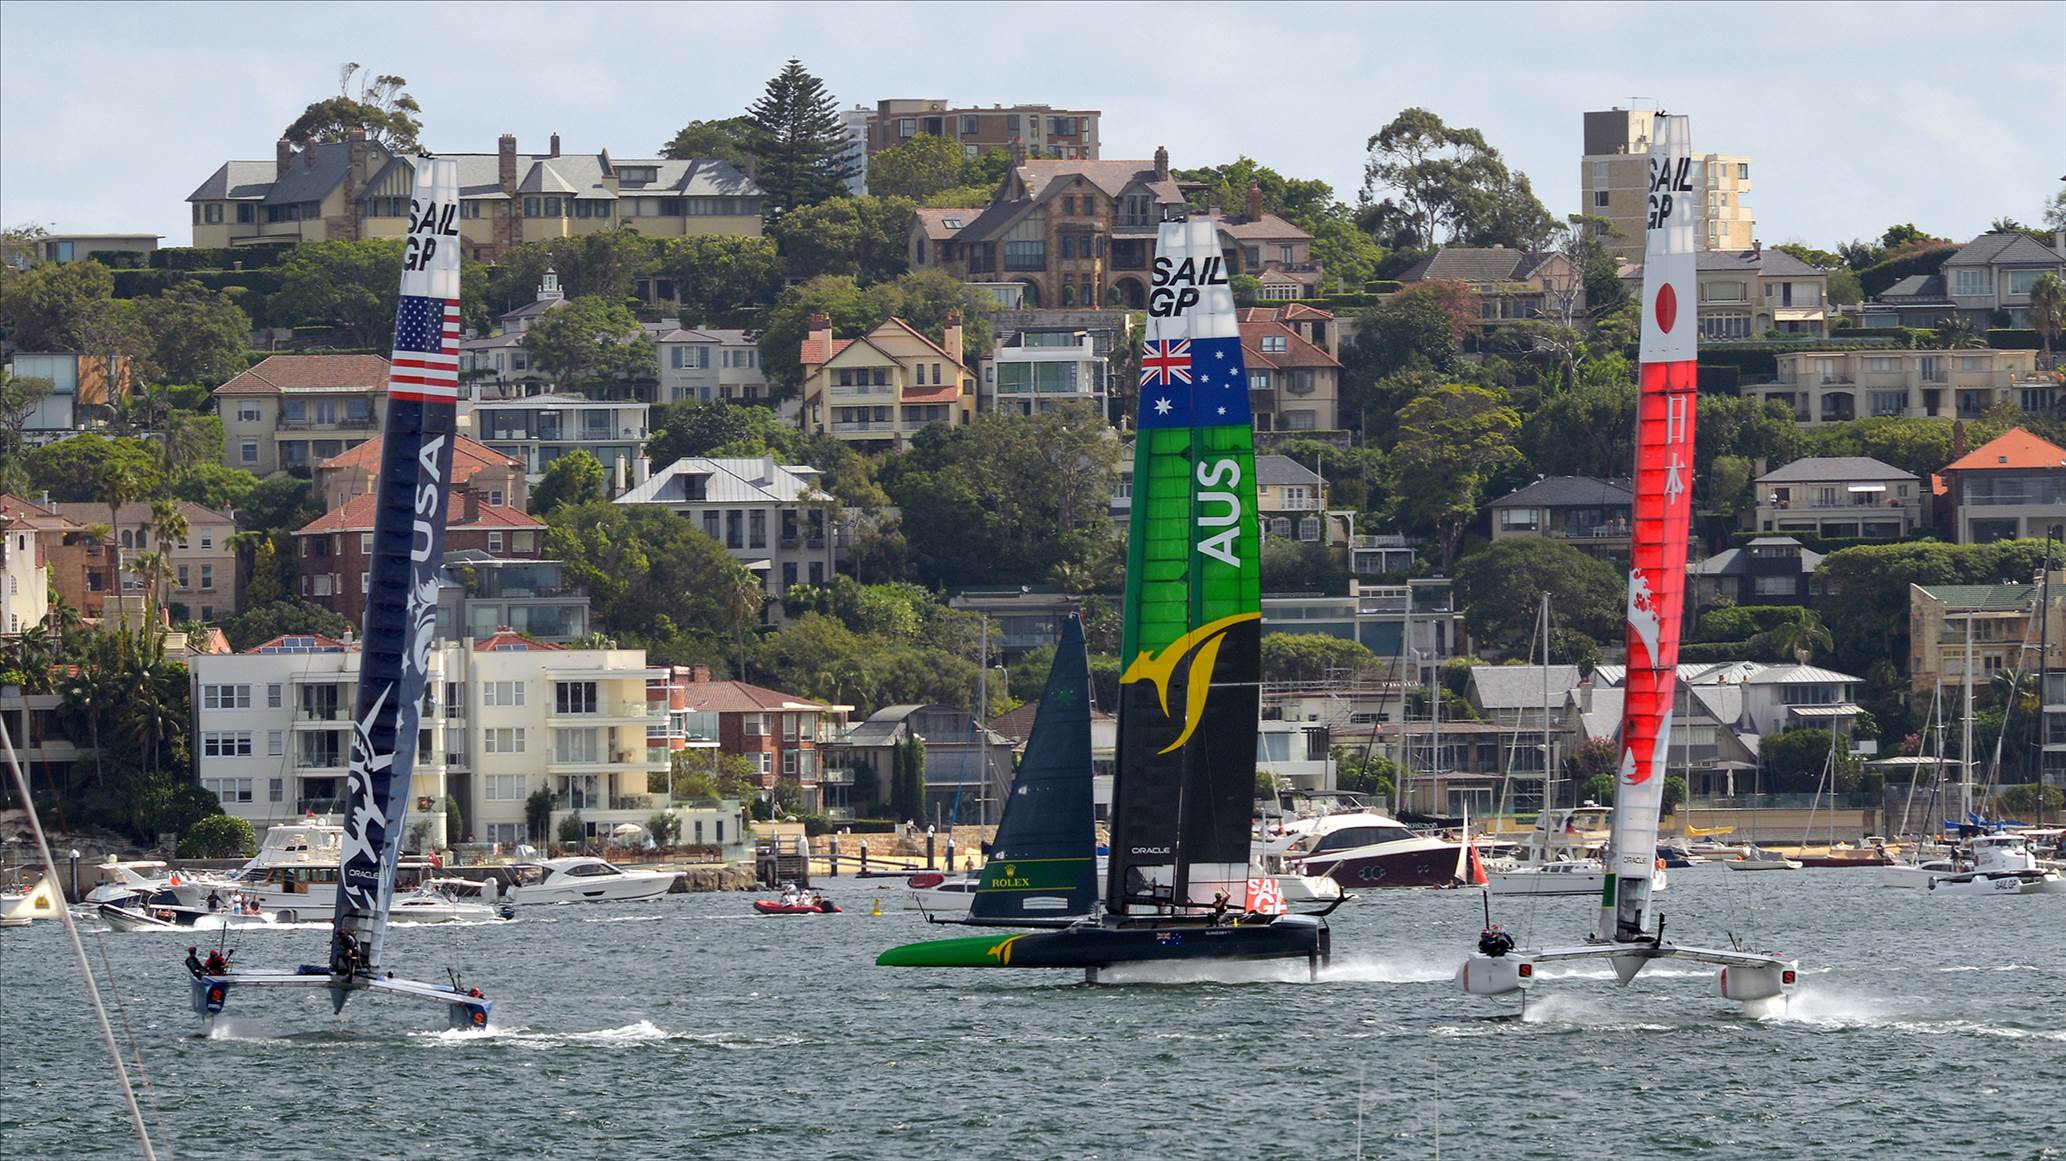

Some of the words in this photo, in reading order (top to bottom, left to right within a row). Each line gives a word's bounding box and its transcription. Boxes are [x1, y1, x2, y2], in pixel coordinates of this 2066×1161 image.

[1648, 157, 1693, 192] SAIL
[408, 199, 458, 235] SAIL
[1648, 194, 1673, 230] GP
[403, 236, 437, 271] GP
[1151, 256, 1228, 286] SAIL
[1148, 287, 1200, 317] GP
[1664, 394, 1687, 505] 日本
[410, 434, 445, 562] USA
[1197, 458, 1241, 569] AUS
[349, 869, 381, 880] ORACLE
[1623, 856, 1647, 865] ORACLE
[992, 878, 1029, 888] ROLEX
